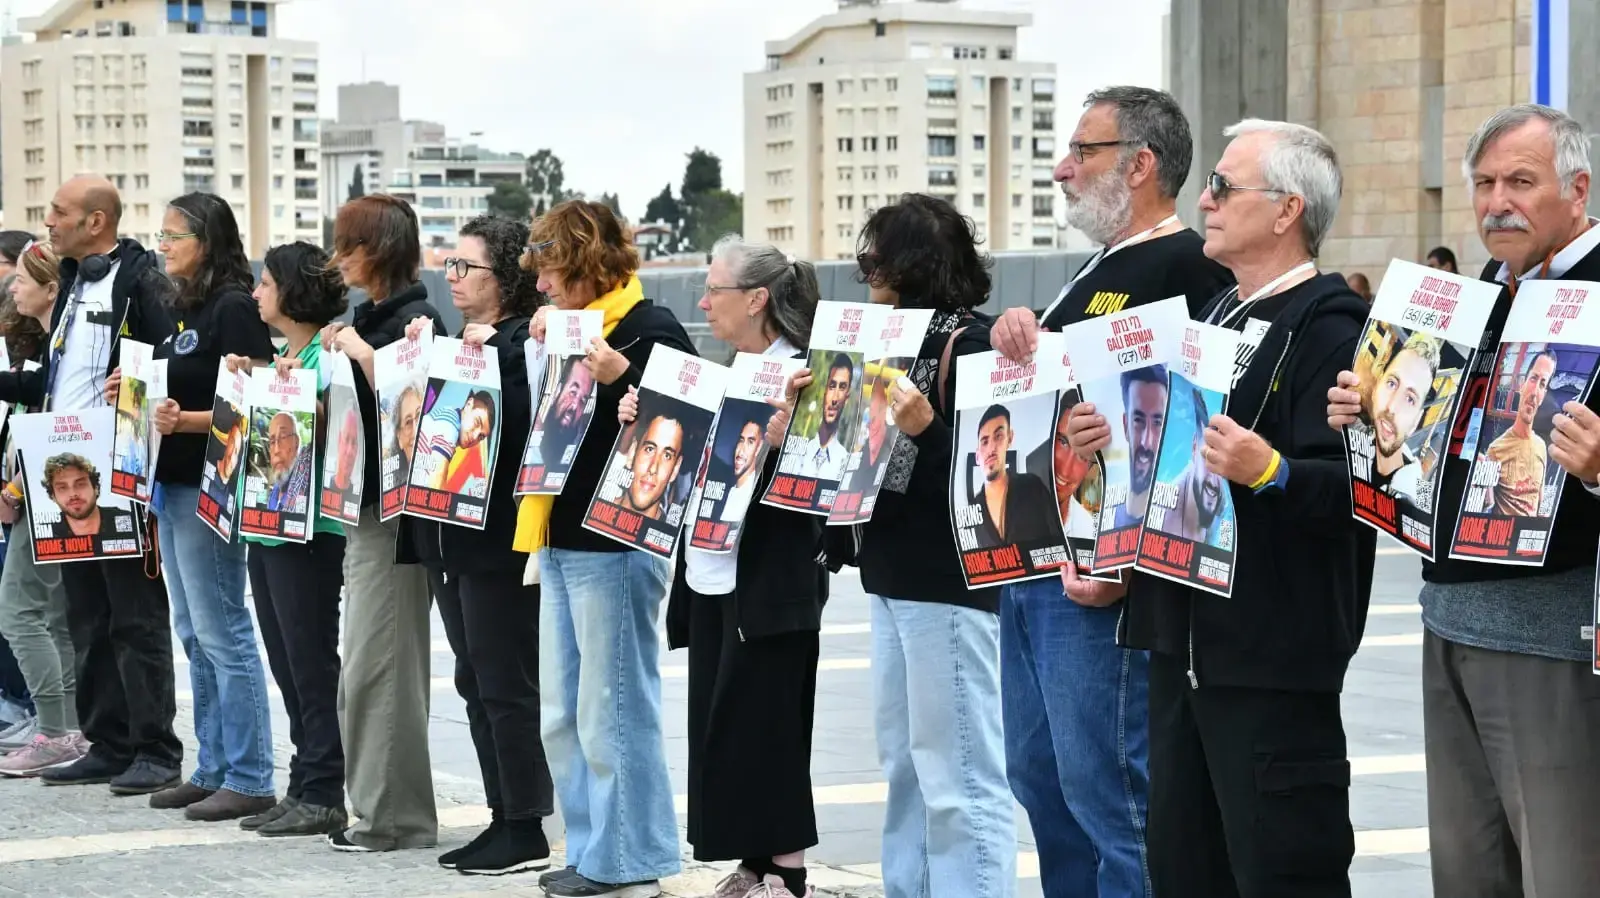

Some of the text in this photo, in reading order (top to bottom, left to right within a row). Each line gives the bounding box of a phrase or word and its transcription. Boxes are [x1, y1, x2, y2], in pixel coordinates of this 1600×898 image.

[1084, 291, 1130, 316] NOW
[1410, 290, 1458, 313] ELKANA BOHBOT
[1546, 304, 1563, 318] AVIV
[1111, 315, 1141, 336] גלי ברמן
[1106, 328, 1154, 352] GALI BERMAN
[1117, 349, 1139, 366] (27)
[991, 370, 1004, 384] ROM
[54, 423, 83, 433] ALON OHEL
[785, 434, 809, 456] BRING
[1348, 428, 1376, 459] BRING
[383, 454, 399, 474] BRING
[1471, 460, 1502, 486] BRING
[383, 473, 394, 492] HER
[606, 467, 634, 489] BRING
[771, 476, 796, 496] HOME
[793, 479, 818, 500] NOW!
[408, 487, 429, 507] HOME
[429, 491, 451, 511] NOW!
[704, 480, 726, 501] BRING
[1151, 483, 1179, 509] BRING
[1353, 480, 1396, 525] HOME NOW!
[1464, 486, 1487, 512] HIM
[34, 511, 61, 525] BRING
[591, 501, 644, 535] HOME NOW!
[699, 499, 714, 519] HIM
[955, 503, 983, 529] BRING
[1146, 504, 1165, 532] HIM
[34, 523, 54, 539] HIM
[694, 520, 714, 540] HOME
[958, 527, 979, 552] HIM
[1458, 516, 1488, 543] HOME
[1486, 516, 1515, 546] NOW!
[36, 539, 64, 555] HOME
[65, 537, 93, 552] NOW!
[1097, 532, 1119, 558] HOME
[1142, 531, 1168, 560] HOME
[1166, 539, 1194, 568] NOW!
[963, 550, 994, 575] HOME
[992, 543, 1023, 570] NOW!
